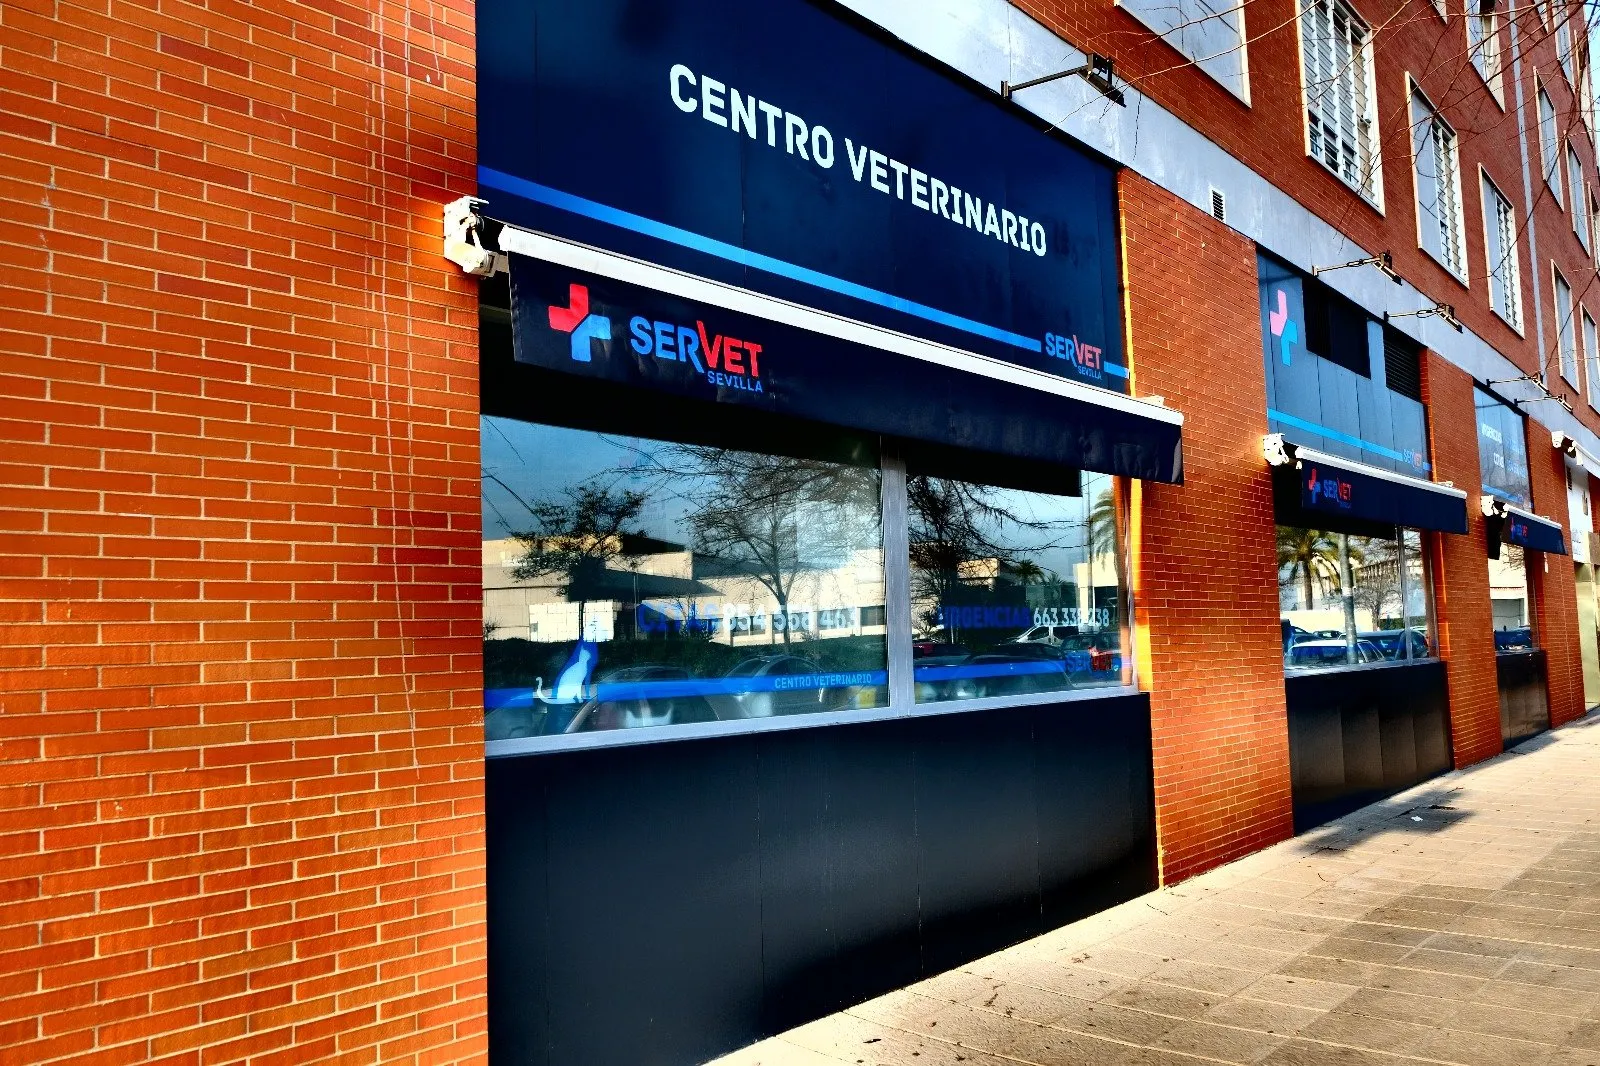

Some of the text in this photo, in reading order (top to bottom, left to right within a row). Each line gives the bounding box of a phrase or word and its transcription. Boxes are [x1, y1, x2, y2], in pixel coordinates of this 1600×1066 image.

[669, 63, 1047, 257] CENTRO VETERINARIO
[629, 315, 763, 377] SERVET
[1045, 332, 1102, 369] SERVET
[707, 370, 764, 394] SEVILLA
[1077, 365, 1102, 380] SEVILLA
[1033, 607, 1059, 627] 663
[775, 673, 872, 689] CENTRO VETERINARIO
